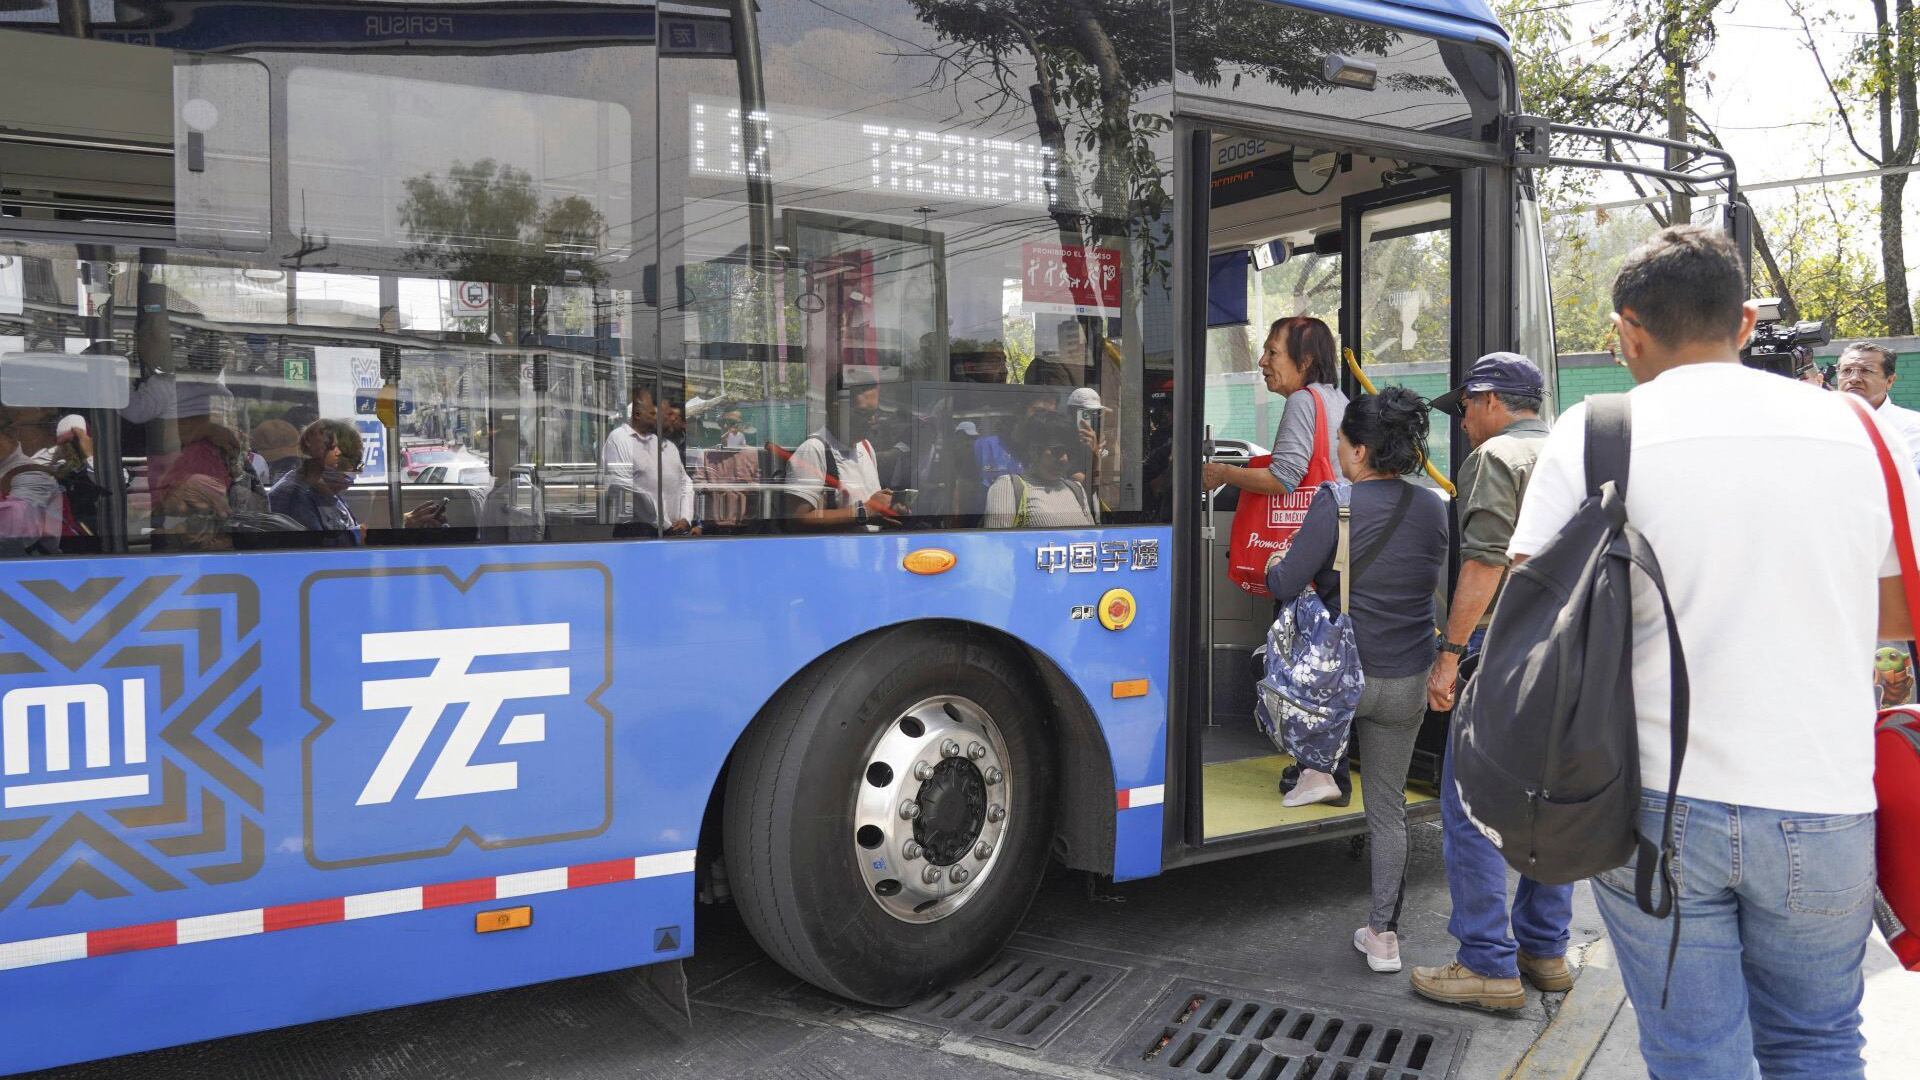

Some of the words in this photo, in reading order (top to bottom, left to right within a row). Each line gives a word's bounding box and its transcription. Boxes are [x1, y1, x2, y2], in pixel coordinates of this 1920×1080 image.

[1218, 140, 1266, 165] 20092
[1032, 247, 1072, 257] PROHIBIDO
[1084, 251, 1112, 260] ACCESO
[1271, 493, 1281, 508] EL
[1283, 491, 1313, 508] OUTLET
[1274, 512, 1283, 521] DE
